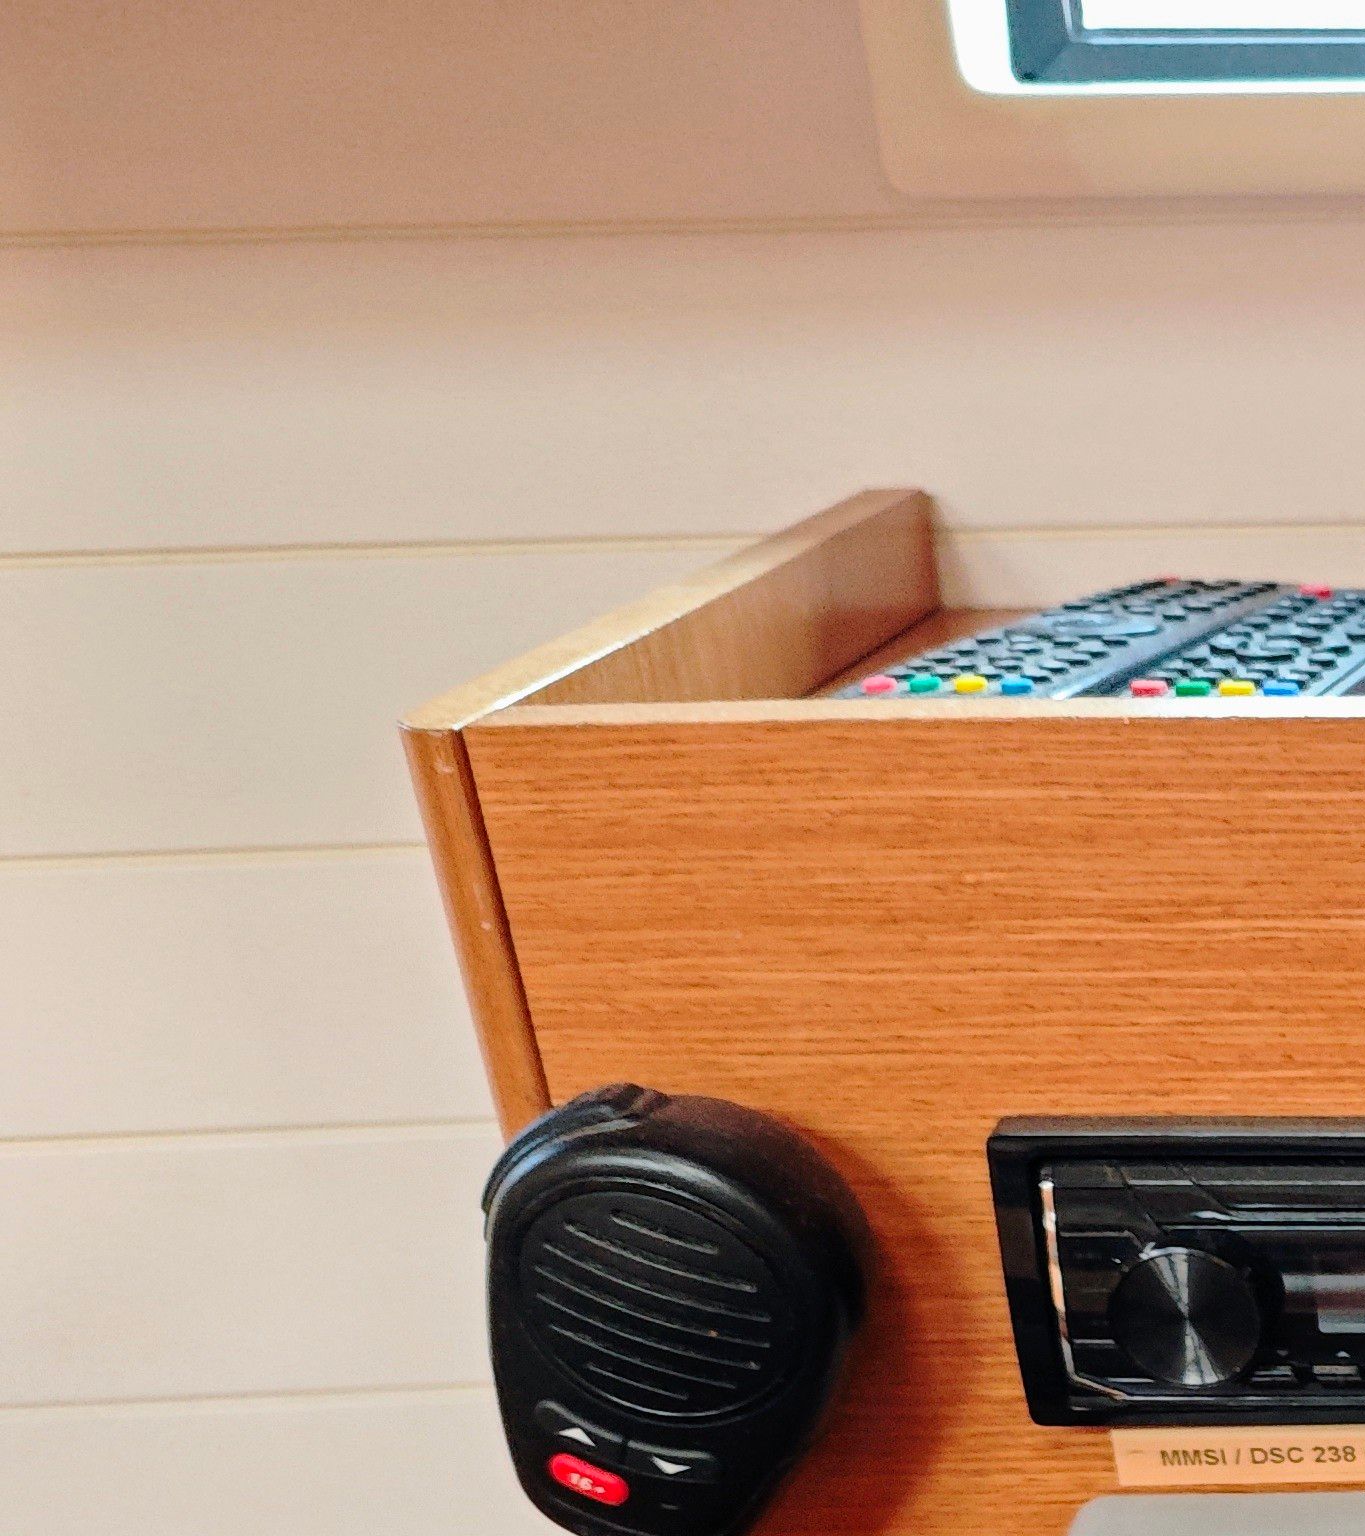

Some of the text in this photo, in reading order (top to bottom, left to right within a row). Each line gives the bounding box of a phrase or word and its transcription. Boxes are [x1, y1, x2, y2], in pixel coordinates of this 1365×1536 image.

[1161, 1449, 1227, 1466] MMSI
[1250, 1446, 1304, 1465] DSC
[1312, 1445, 1356, 1463] 238
